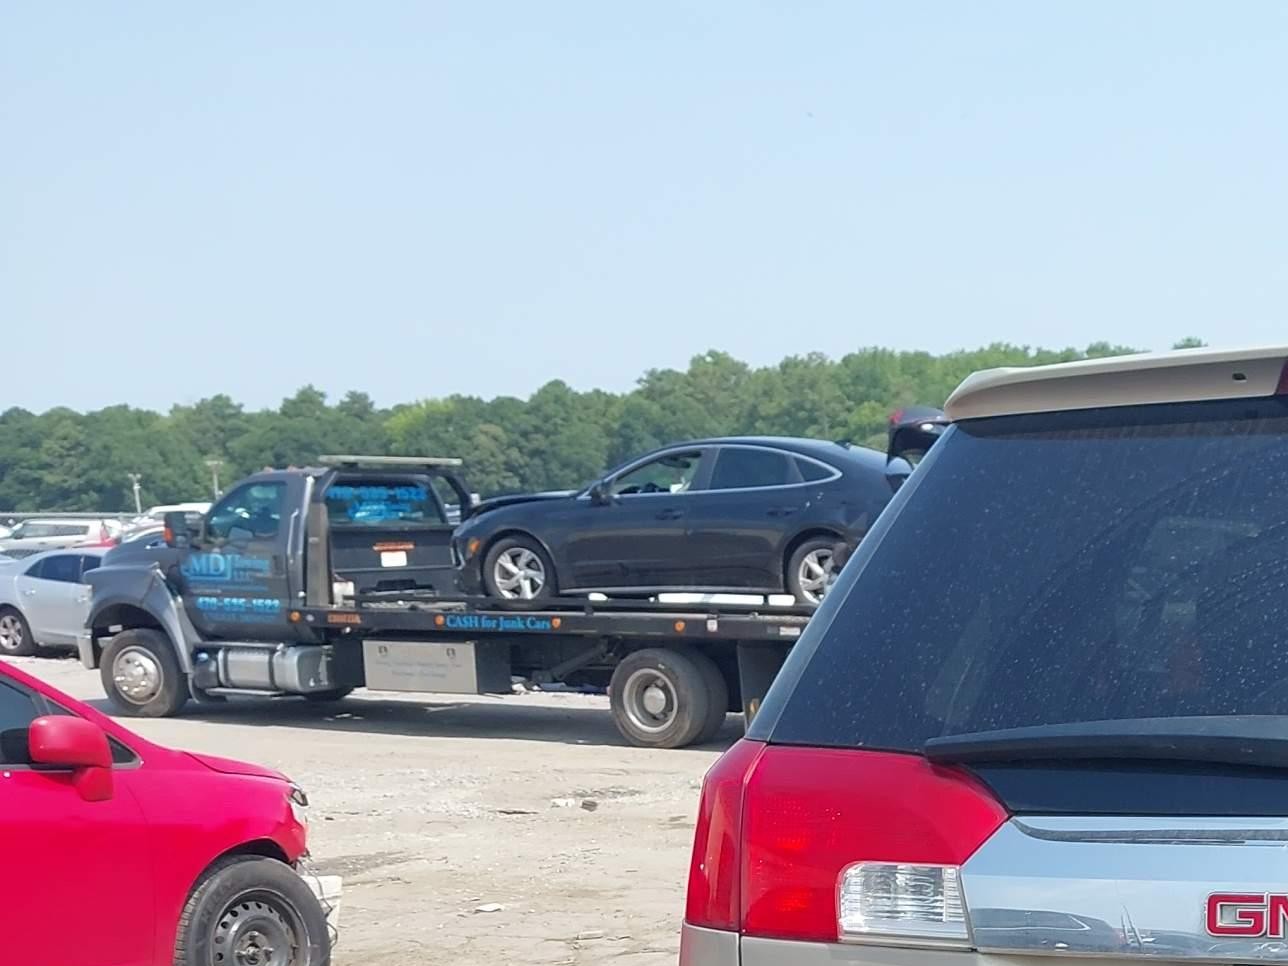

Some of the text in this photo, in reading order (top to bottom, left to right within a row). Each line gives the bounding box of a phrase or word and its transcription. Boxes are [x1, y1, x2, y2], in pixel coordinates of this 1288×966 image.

[446, 614, 551, 631] CASH for Junk Cars
